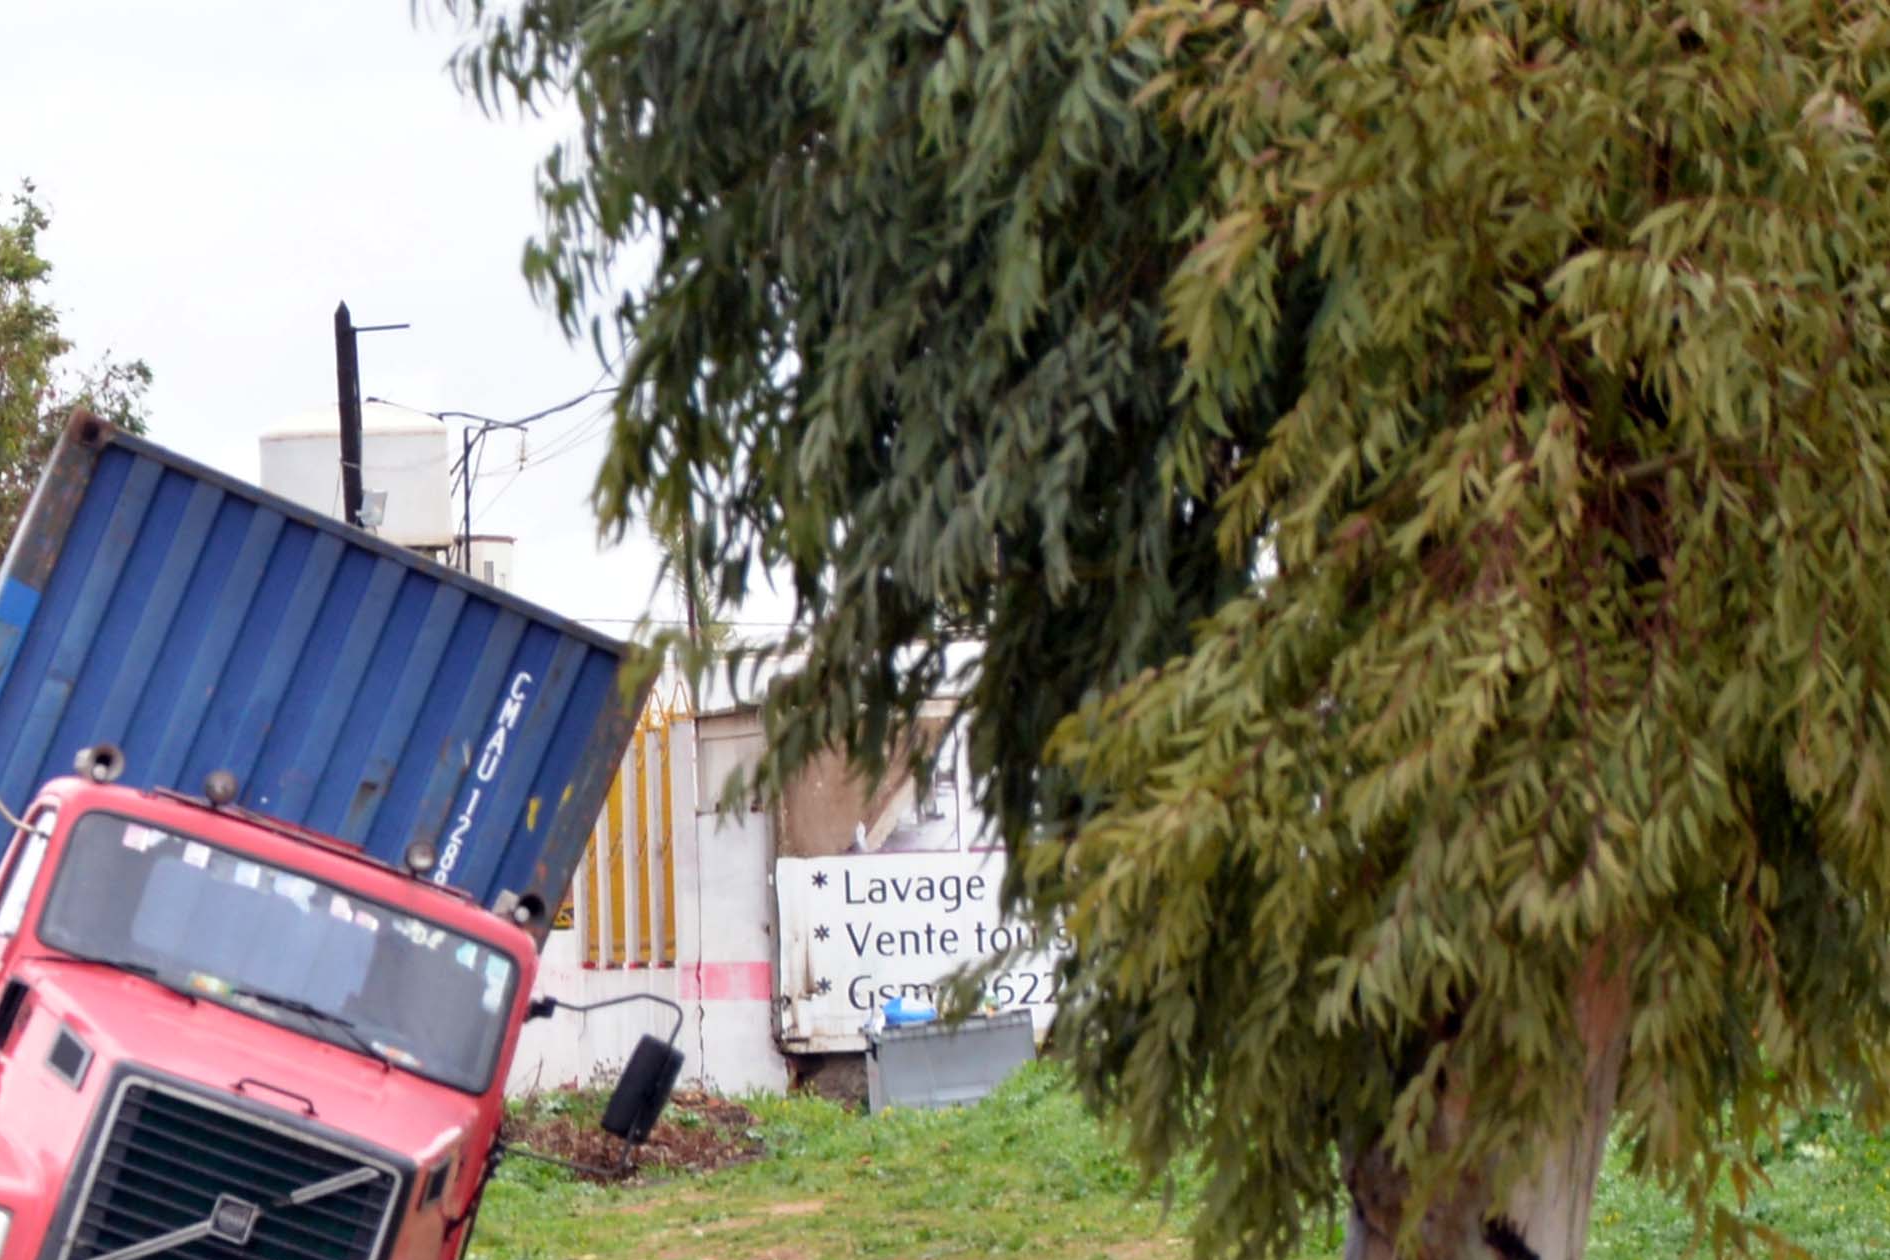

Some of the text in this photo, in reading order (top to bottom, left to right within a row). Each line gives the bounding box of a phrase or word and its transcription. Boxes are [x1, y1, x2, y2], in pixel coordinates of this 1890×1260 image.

[476, 671, 533, 782] CMAU
[843, 869, 986, 912] Lavage
[845, 921, 959, 957] Vente
